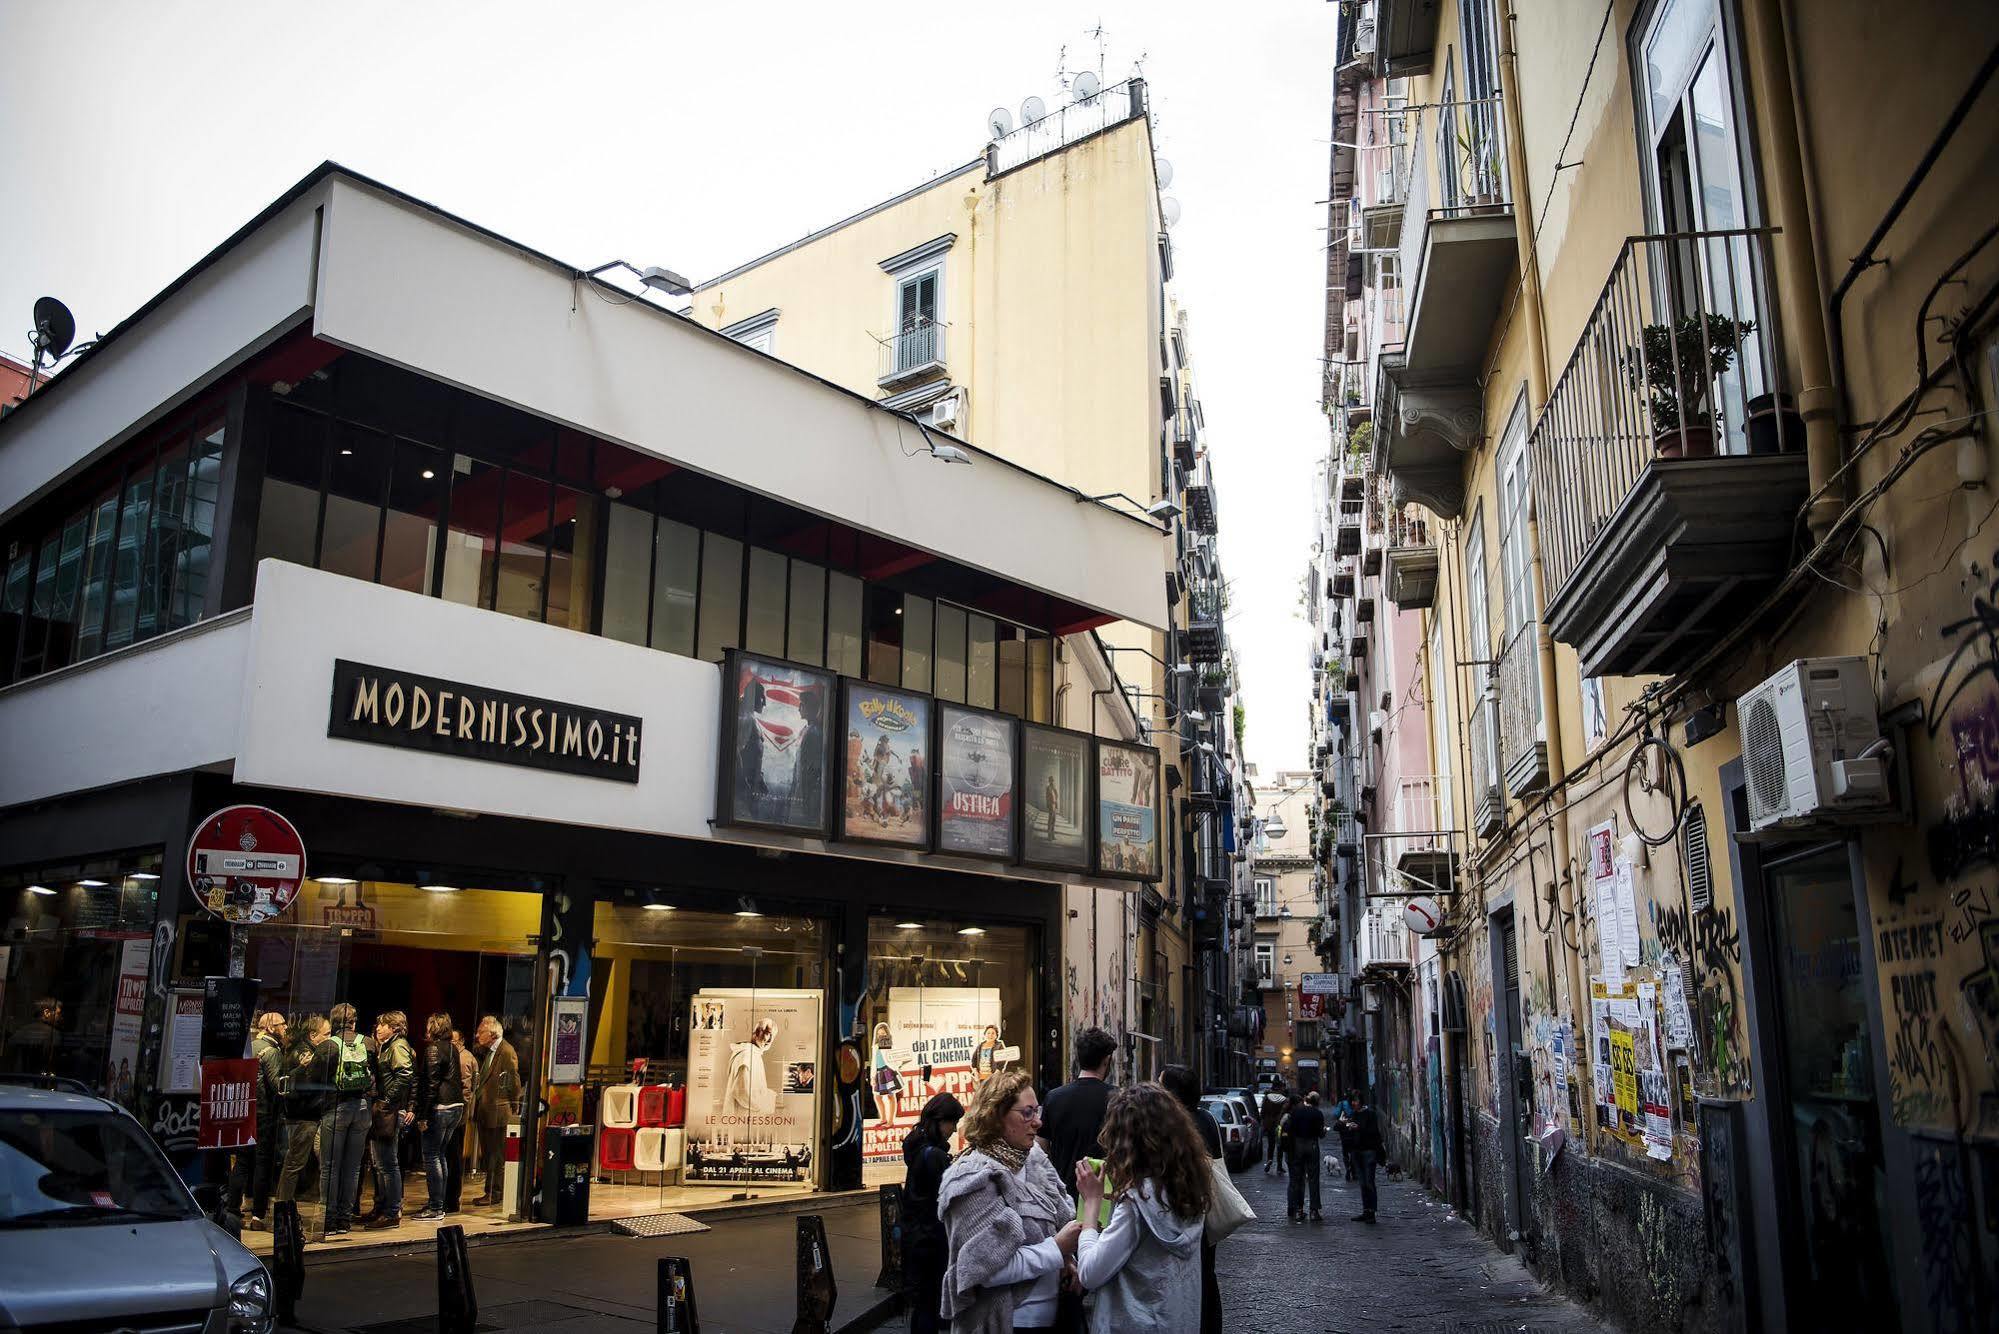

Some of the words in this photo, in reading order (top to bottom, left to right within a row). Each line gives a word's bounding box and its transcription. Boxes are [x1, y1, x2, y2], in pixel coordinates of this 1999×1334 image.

[353, 676, 638, 766] MODERNISSIMO.it
[953, 791, 1000, 815] USTICA
[912, 1041, 929, 1053] dal
[932, 1040, 938, 1051] 7
[940, 1036, 974, 1049] APRILE
[917, 1053, 929, 1065] AL
[932, 1049, 971, 1063] CINEMA
[705, 1115, 717, 1125] LE
[721, 1115, 796, 1126] CONFESSIONI
[765, 1167, 794, 1175] CINEMA
